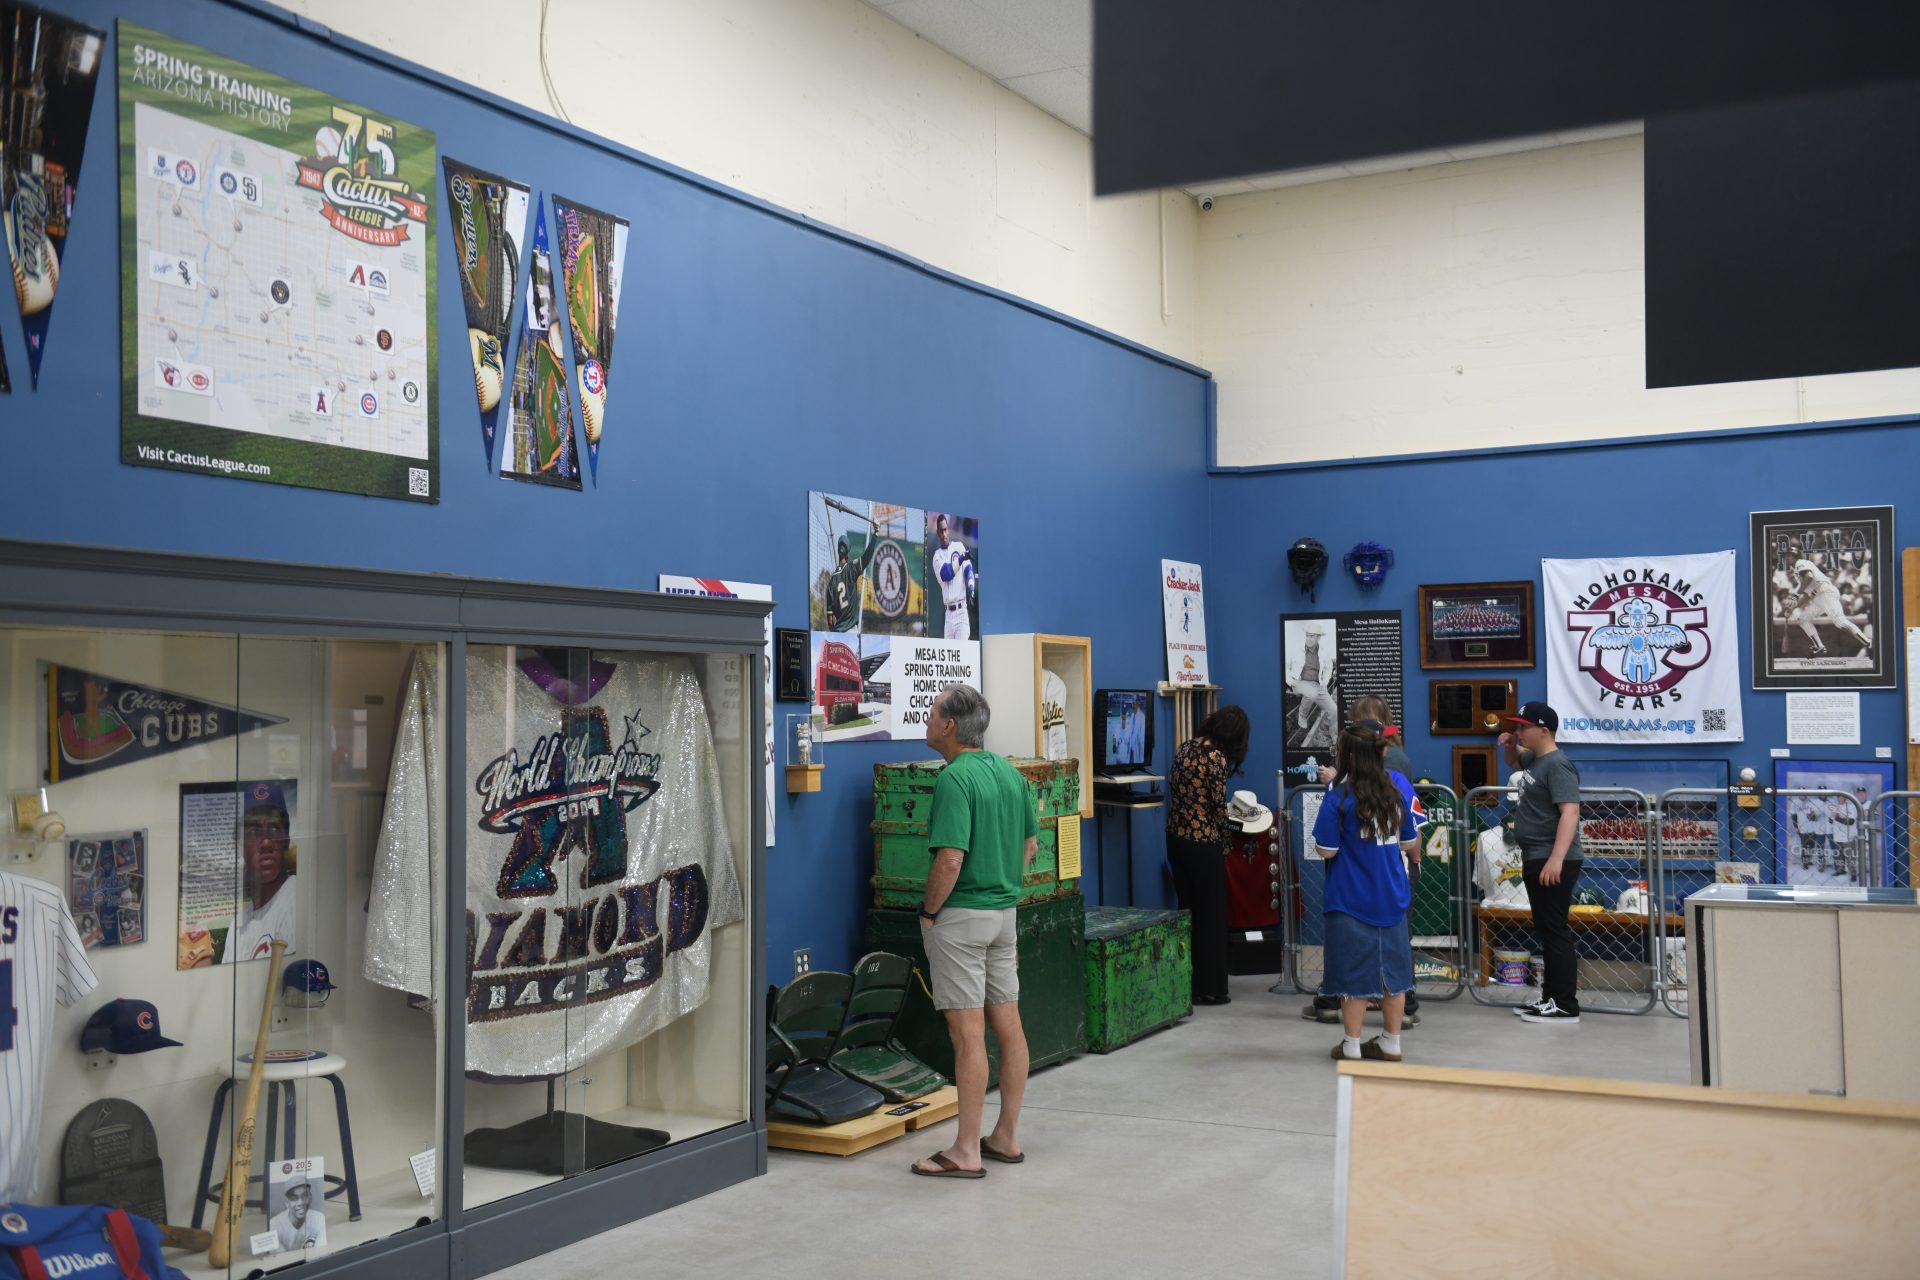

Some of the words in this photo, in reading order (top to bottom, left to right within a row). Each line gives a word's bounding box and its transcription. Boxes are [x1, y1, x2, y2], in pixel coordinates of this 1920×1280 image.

[134, 45, 203, 84] SPRING
[207, 70, 292, 115] TRAINING
[133, 66, 215, 108] ARIZONA
[221, 95, 292, 133] HISTORY
[331, 104, 397, 176] 75
[322, 166, 395, 211] Cactus
[335, 216, 396, 242] ANNIVERSARY
[348, 206, 384, 229] LEAGUE
[452, 174, 478, 272] Brewers
[564, 208, 582, 274] TEXAS
[138, 445, 165, 461] Visit
[166, 450, 271, 477] CactusLeague.com
[1776, 529, 1866, 572] RYNO
[837, 581, 849, 609] 2
[1167, 575, 1188, 591] Cracker
[1188, 578, 1201, 592] Jack
[1573, 568, 1704, 611] HOHOKAMS
[1610, 585, 1667, 602] MESA
[1567, 606, 1712, 672] 75
[915, 647, 937, 661] MESA
[938, 649, 945, 662] IS
[947, 650, 961, 662] THE
[828, 661, 849, 675] CHICAGO
[905, 663, 934, 677] SPRING
[935, 664, 972, 678] TRAINING
[913, 679, 937, 692] HOME
[1613, 680, 1633, 693] est.
[1635, 683, 1661, 694] 1951
[118, 689, 187, 714] Chicago
[1599, 688, 1682, 711] YEARS
[141, 711, 220, 748] CUBS
[902, 711, 921, 724] AND
[1563, 717, 1696, 735] HOHOKAMS.org
[479, 738, 561, 812] World
[563, 732, 662, 799] Champions
[1790, 845, 1841, 860] Chicago
[867, 962, 881, 974] 102
[488, 956, 646, 1010] BACKS
[137, 1011, 154, 1031] C
[295, 1160, 312, 1169] 205
[43, 1252, 116, 1280] Wilson
